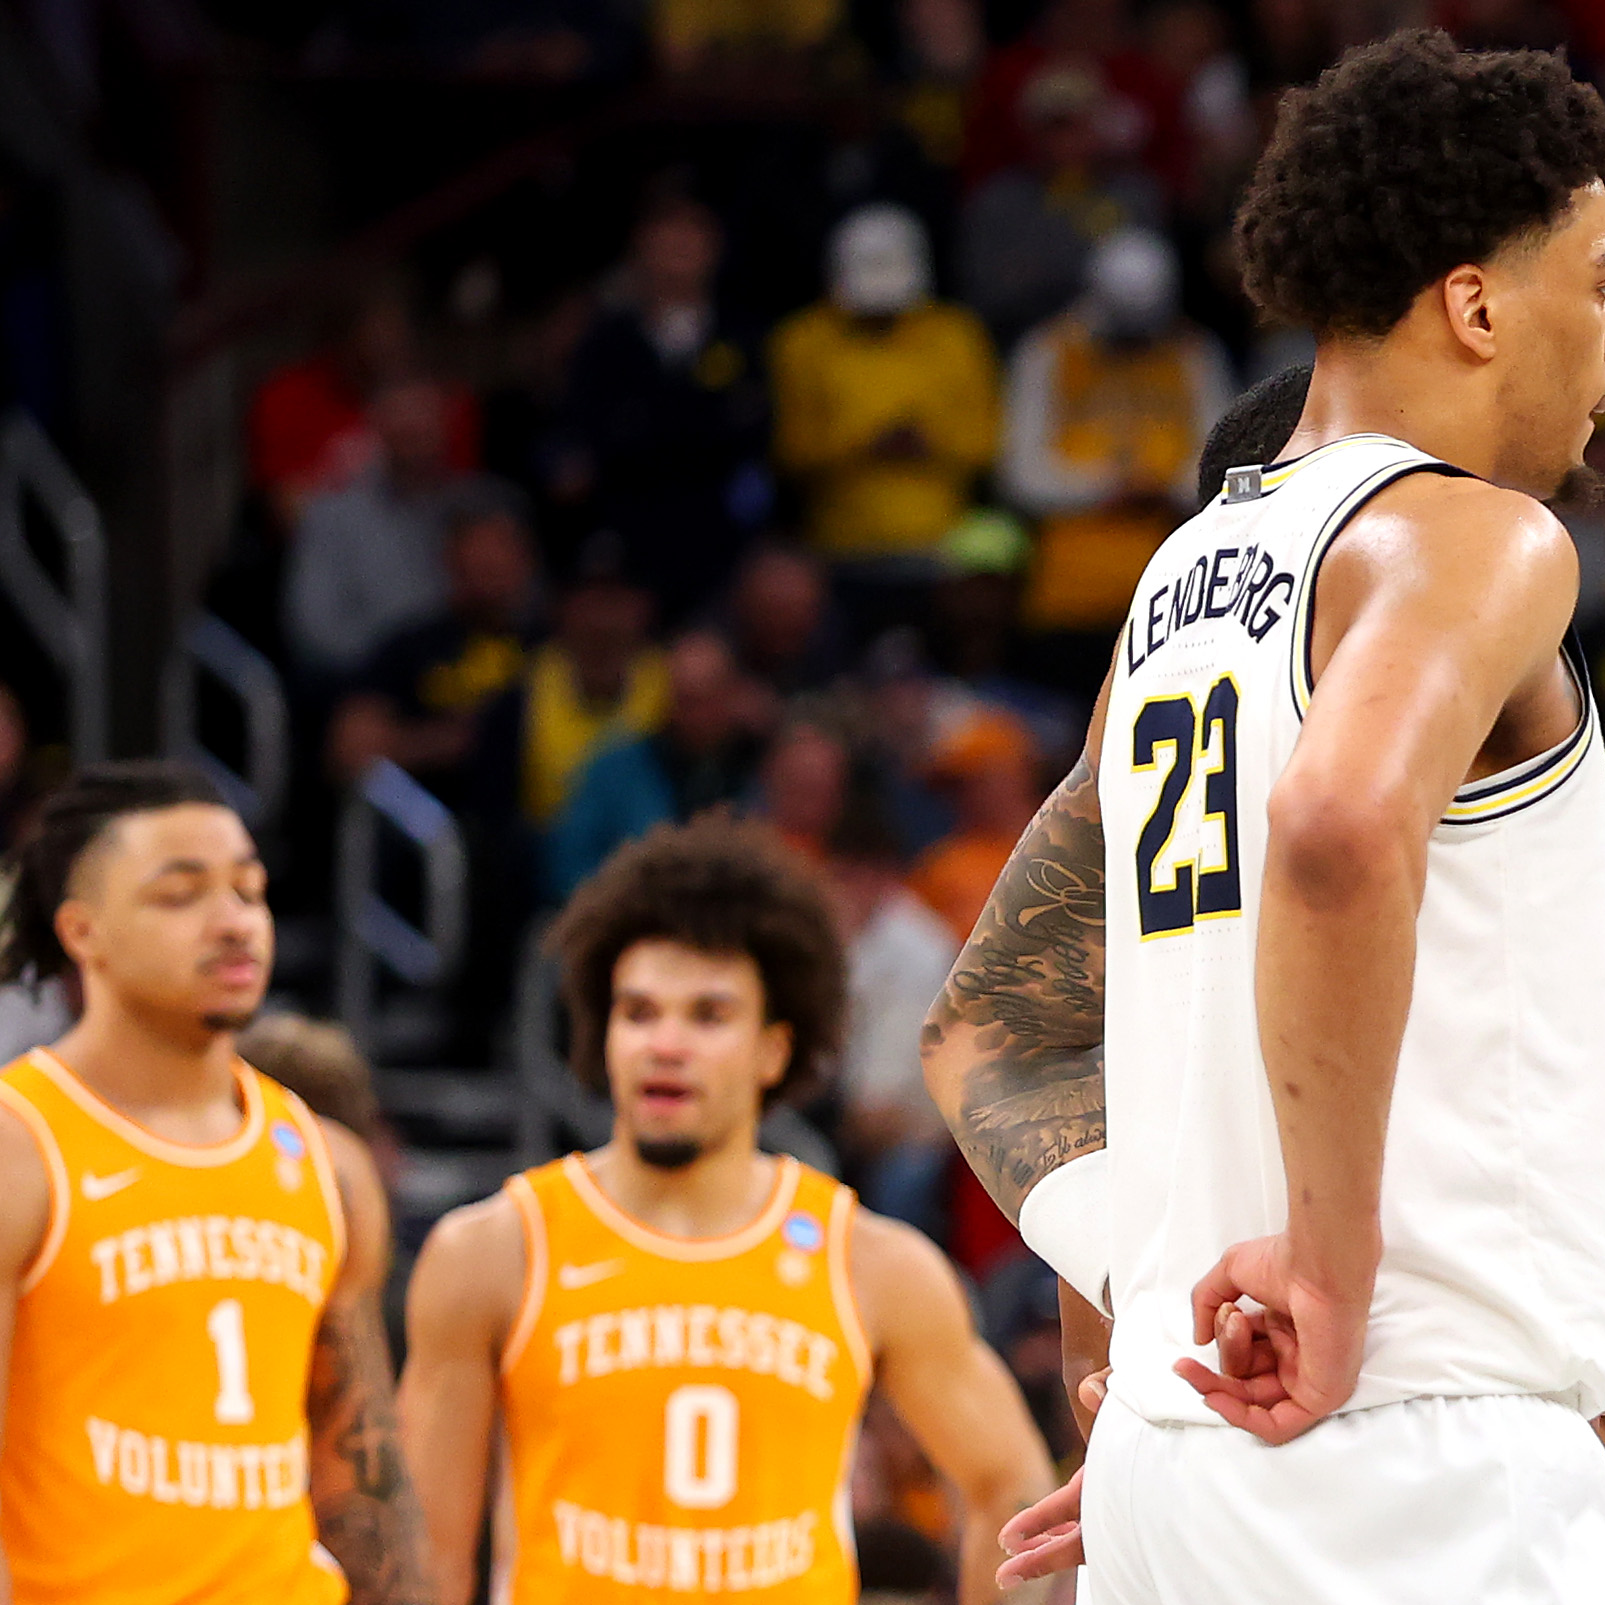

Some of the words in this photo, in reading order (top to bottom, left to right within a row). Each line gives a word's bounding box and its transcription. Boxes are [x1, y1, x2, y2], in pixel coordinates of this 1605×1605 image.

[1131, 670, 1242, 942] 23
[206, 1297, 256, 1426] 1
[553, 1302, 839, 1402] TENNESSEE
[663, 1382, 741, 1511] 0
